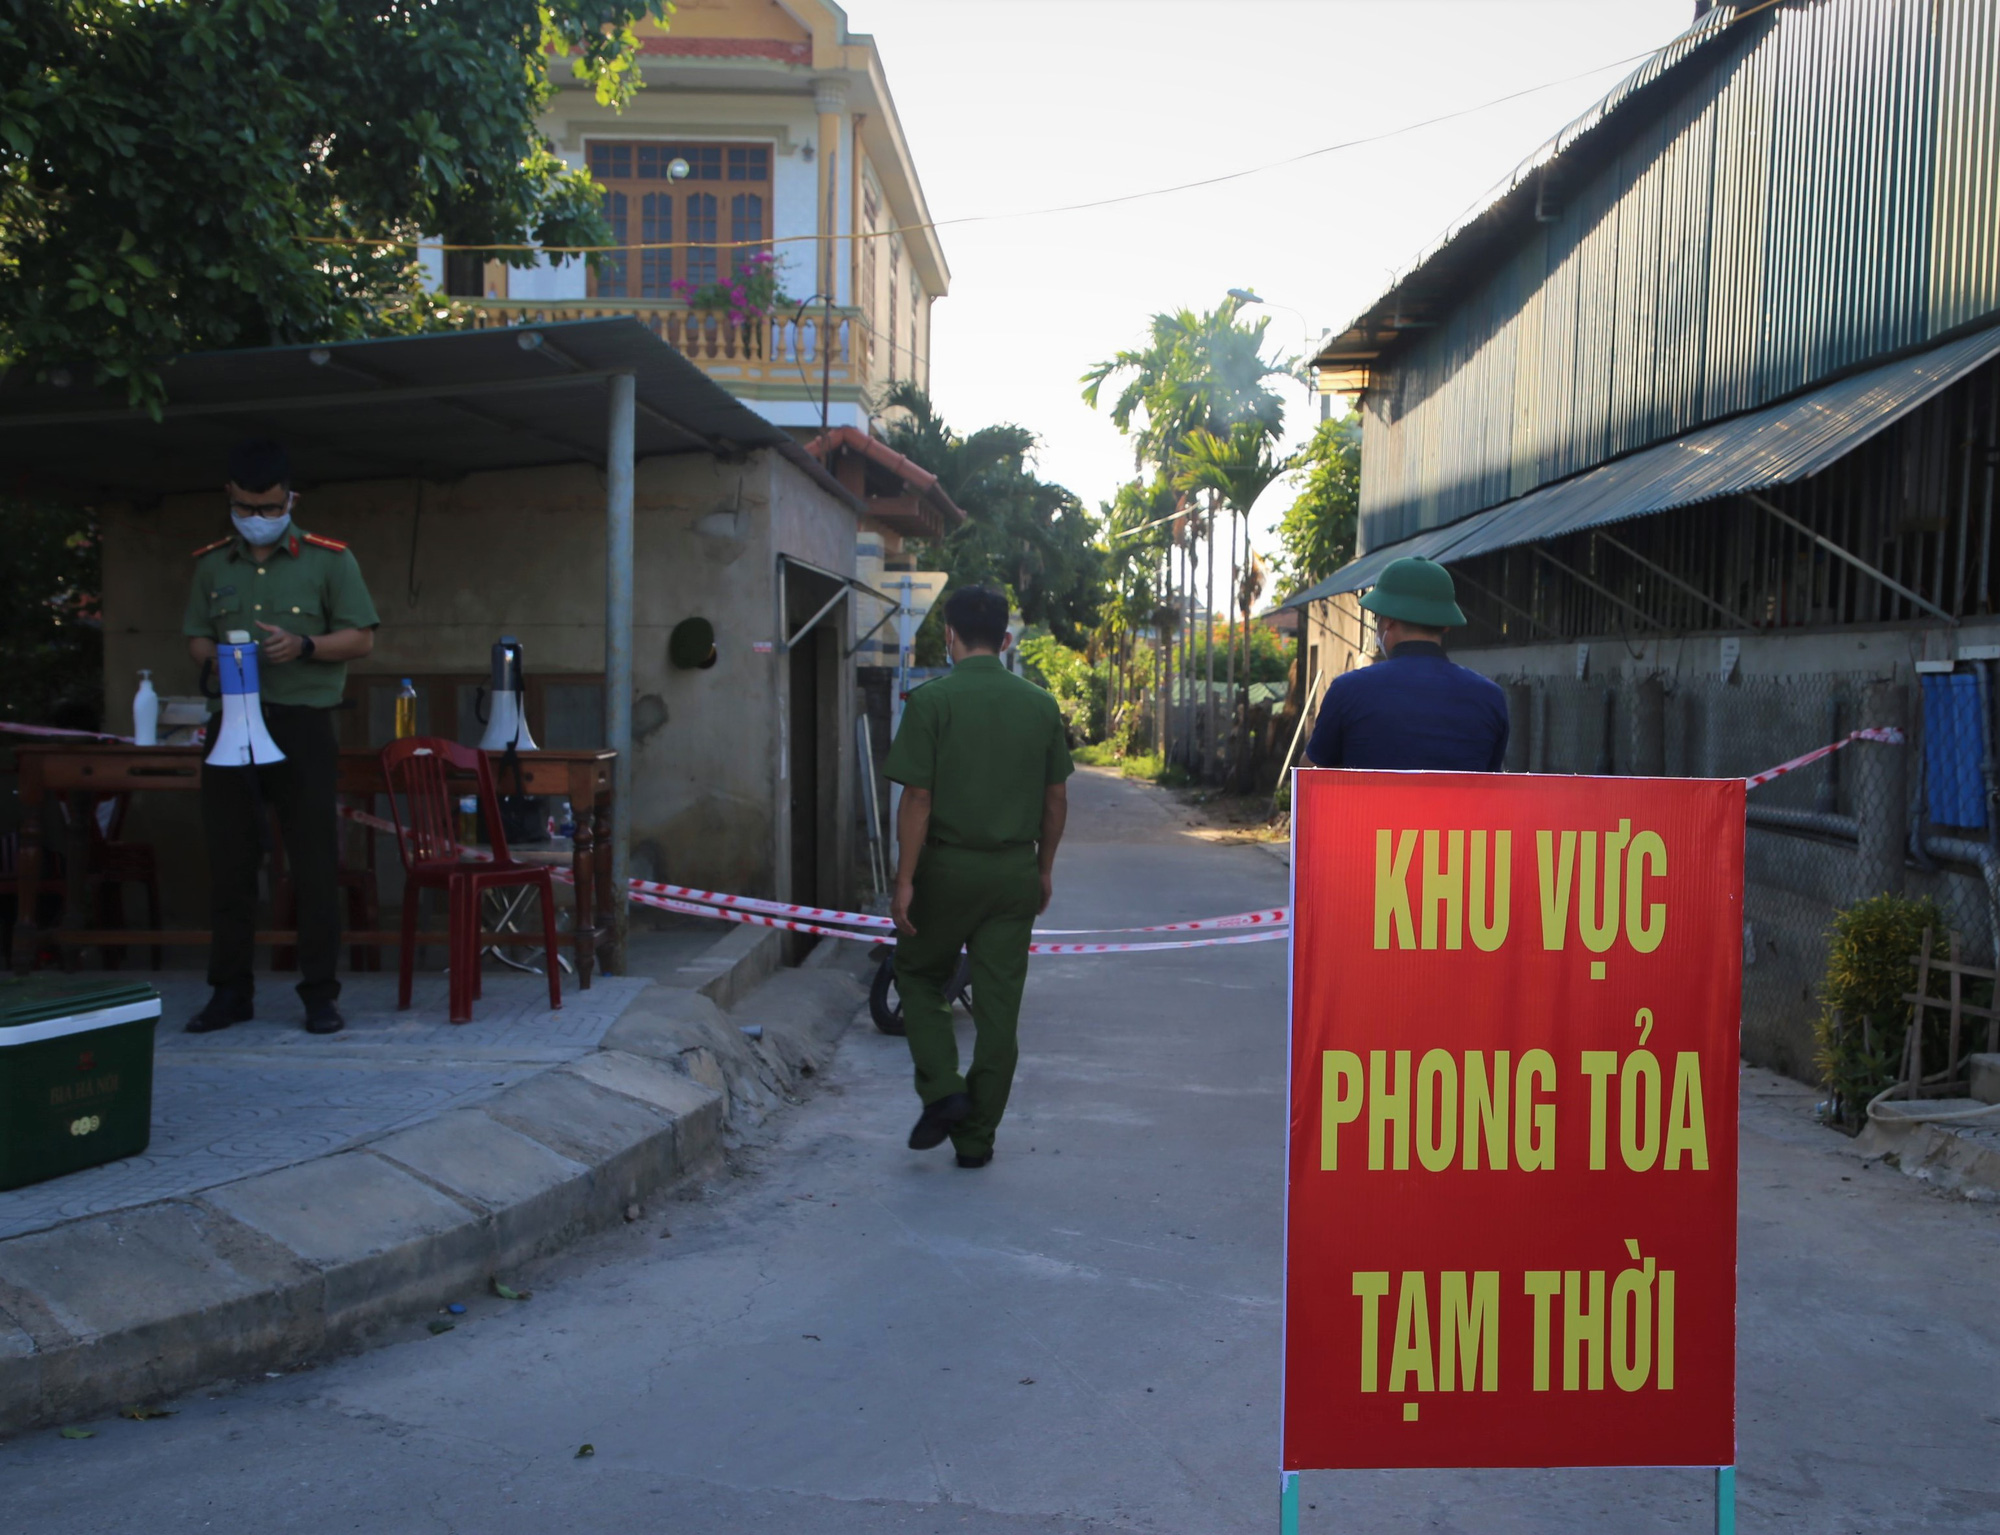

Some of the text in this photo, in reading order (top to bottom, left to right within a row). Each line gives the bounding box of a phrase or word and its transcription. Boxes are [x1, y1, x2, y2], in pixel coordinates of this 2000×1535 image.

[1374, 818, 1668, 980] KHU VỰC
[1320, 1007, 1710, 1172] PHONG TỎA
[1352, 1238, 1675, 1422] TẠM THỜI
